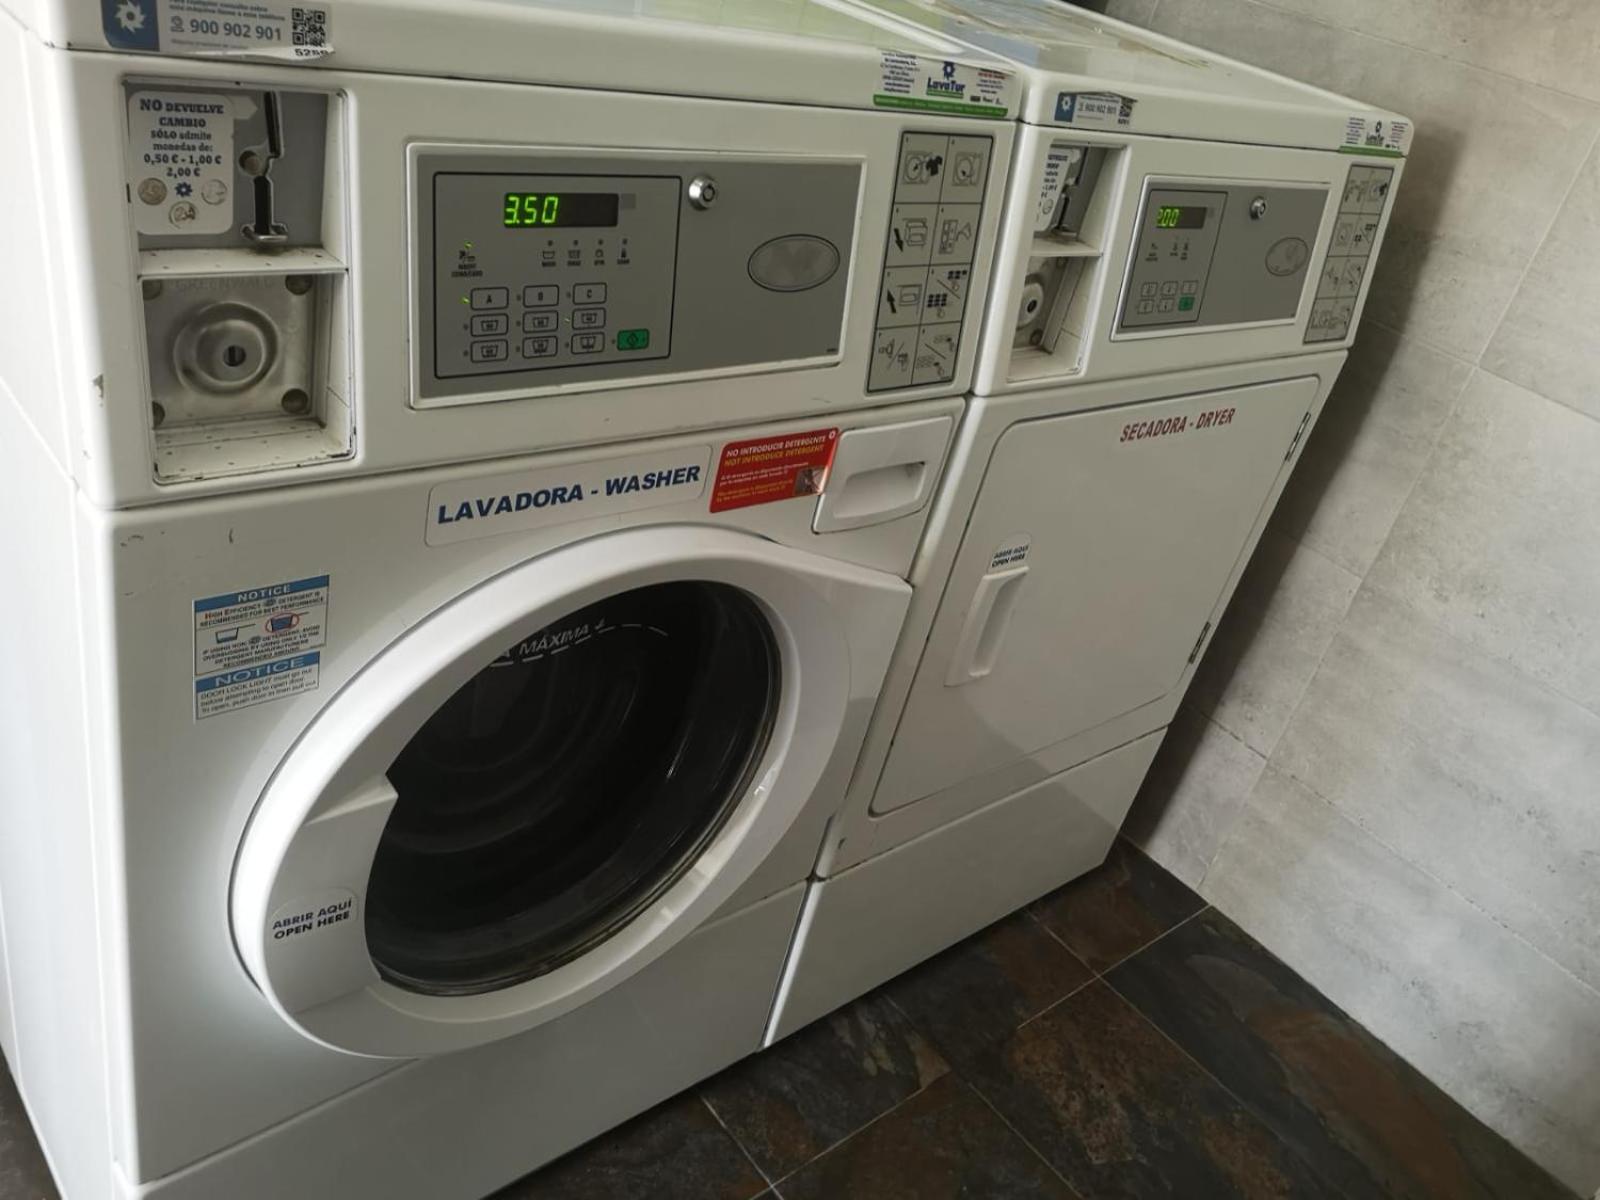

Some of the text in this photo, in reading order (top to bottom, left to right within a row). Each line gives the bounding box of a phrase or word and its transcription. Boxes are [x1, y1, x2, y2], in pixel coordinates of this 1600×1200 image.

[190, 18, 282, 41] 900 902 901
[927, 77, 965, 92] LavaTur
[140, 98, 224, 114] NO DEVUELVE
[159, 117, 206, 127] CAMBIO
[179, 130, 212, 140] admite
[153, 142, 213, 152] monedas de:
[144, 153, 169, 165] 0,50
[171, 154, 178, 163] €
[189, 155, 213, 166] 1,00
[215, 155, 222, 165] €
[166, 167, 201, 178] 2,00 €
[504, 196, 559, 224] 3.50
[486, 295, 493, 304] A
[587, 288, 593, 298] C
[1120, 416, 1188, 443] SECADORA
[1195, 407, 1236, 430] DRYER
[726, 449, 739, 459] NO
[740, 442, 784, 456] INTRODUCIR
[724, 457, 740, 467] NOT
[741, 451, 784, 465] INTRODUCE
[438, 484, 583, 524] LAVADORA
[605, 465, 700, 496] WASHER
[238, 584, 291, 602] NOTICE
[519, 623, 589, 655] MÁXIMA
[215, 656, 305, 687] NOTICE
[226, 684, 249, 693] LOCK
[249, 678, 272, 688] LIGHT
[272, 912, 314, 930] ABRIR
[274, 911, 350, 939] OPEN HERE
